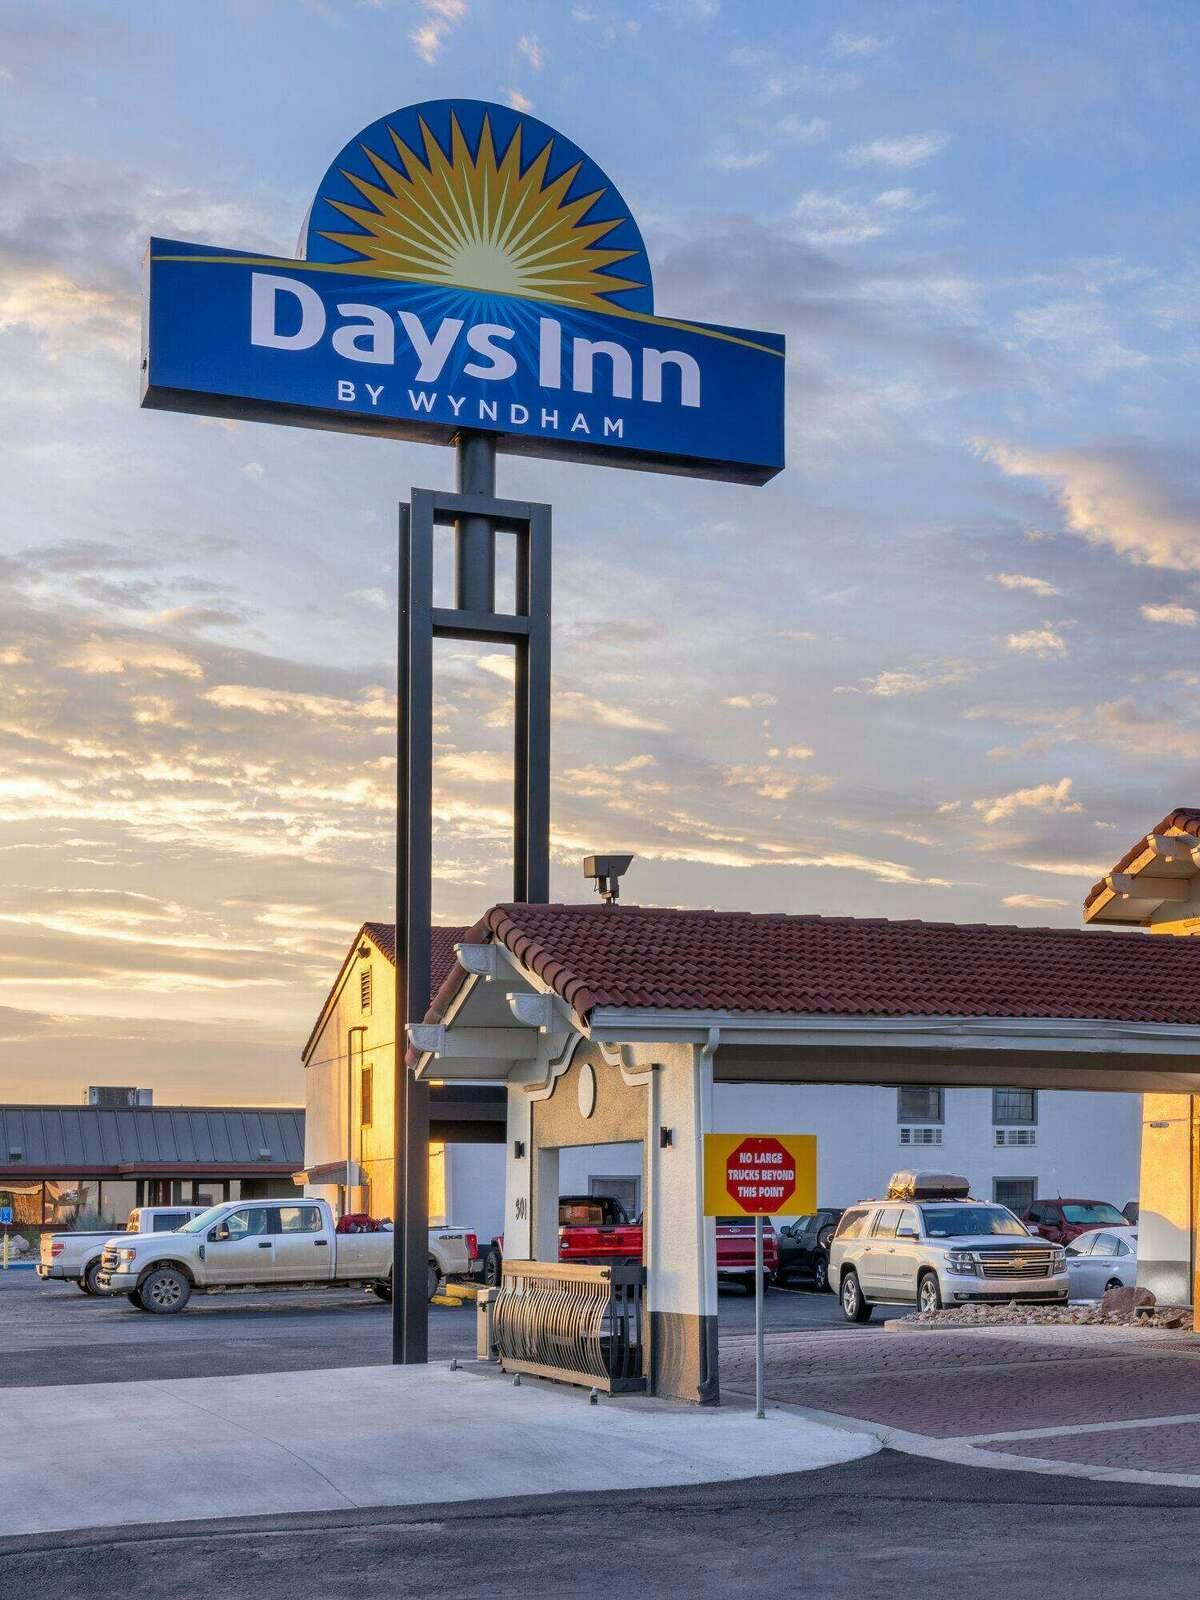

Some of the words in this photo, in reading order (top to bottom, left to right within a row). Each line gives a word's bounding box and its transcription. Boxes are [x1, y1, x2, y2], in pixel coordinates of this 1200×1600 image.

[251, 272, 516, 383] Days
[539, 317, 701, 408] Inn
[338, 380, 385, 405] BY
[408, 389, 623, 438] WYNDHAM
[740, 1153, 752, 1163] NO
[754, 1153, 782, 1163] LARGE
[728, 1169, 759, 1180] TRUCKS
[761, 1170, 794, 1180] BEYOND
[738, 1186, 757, 1197] THIS
[759, 1187, 784, 1197] POINT
